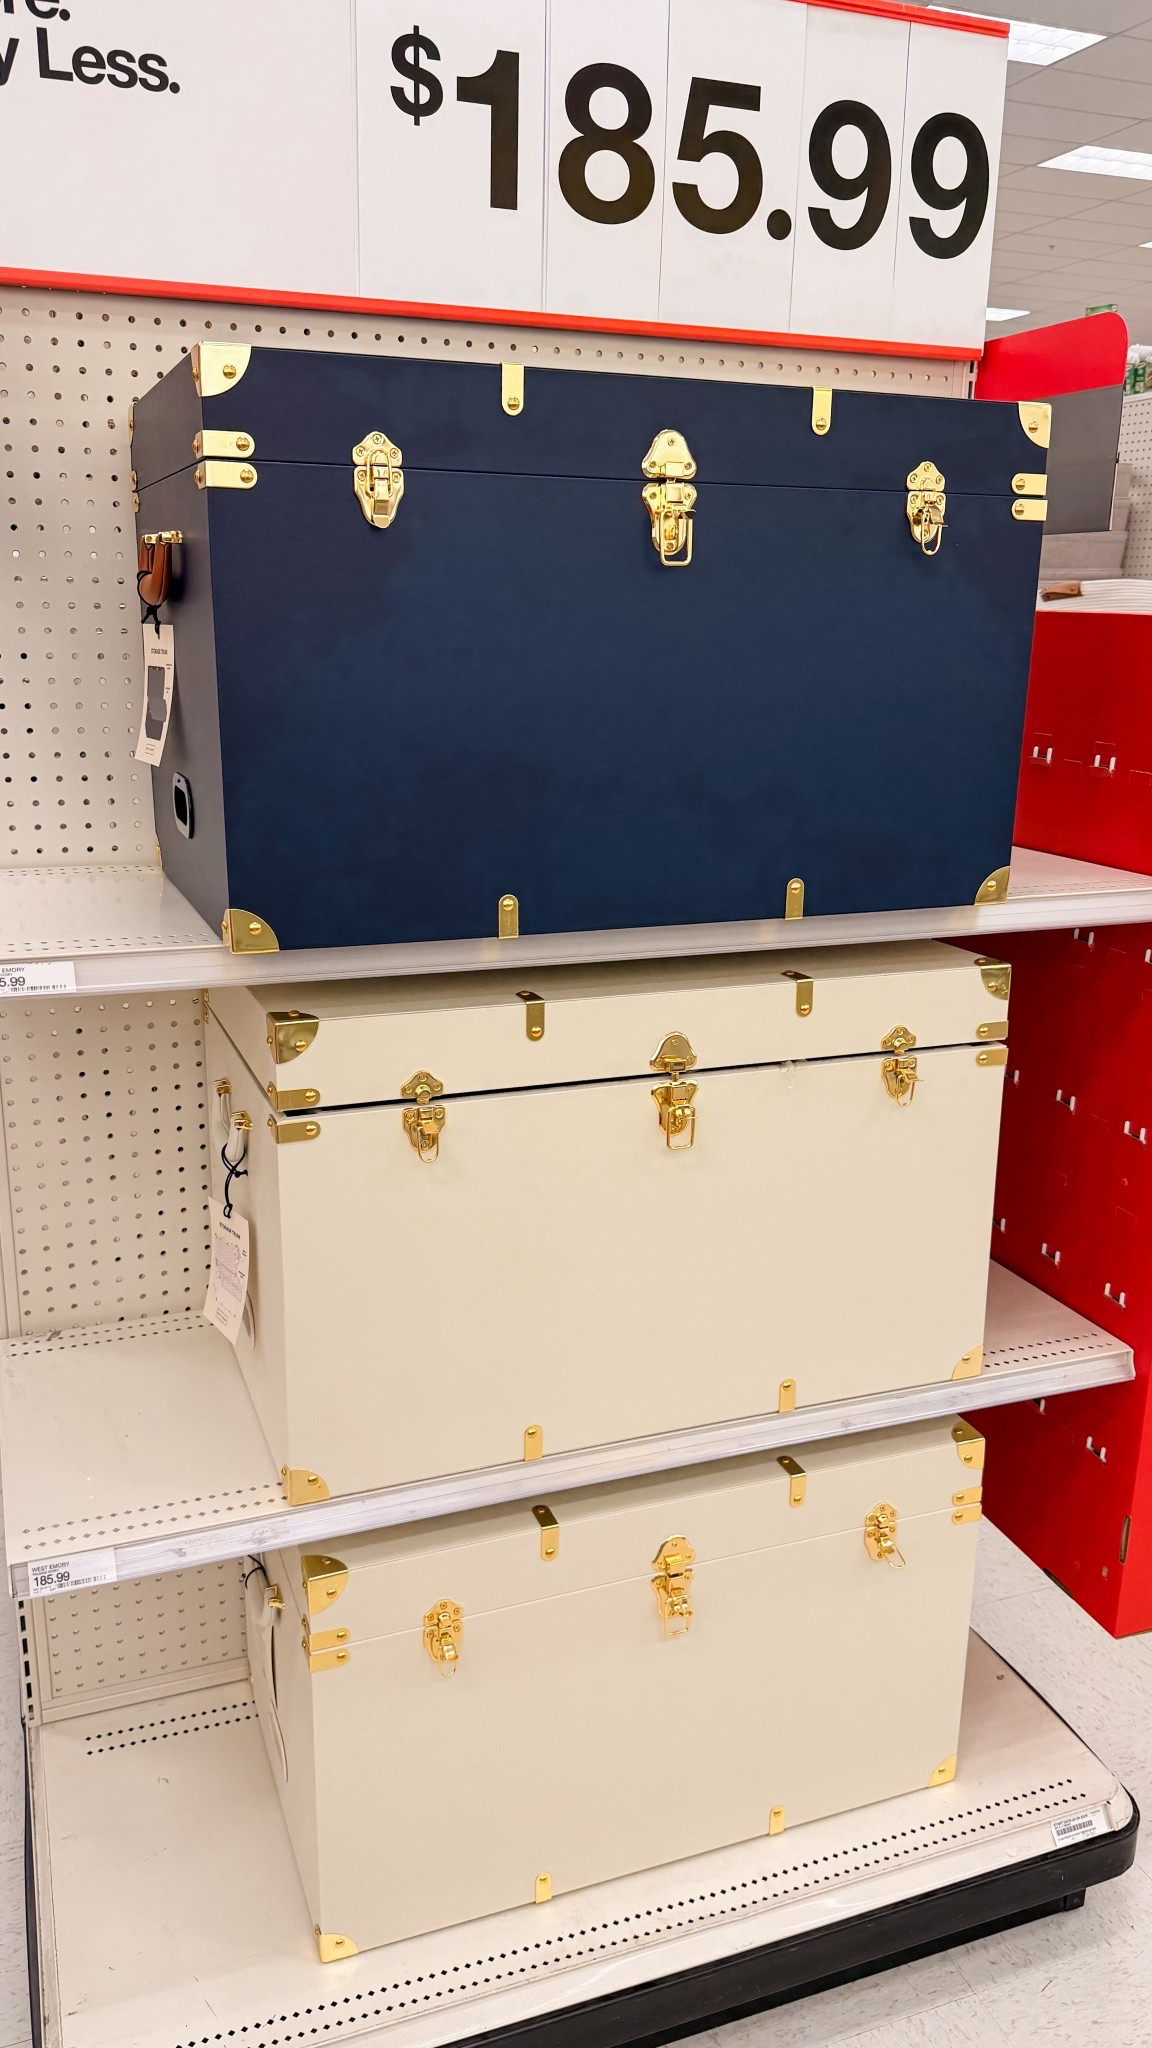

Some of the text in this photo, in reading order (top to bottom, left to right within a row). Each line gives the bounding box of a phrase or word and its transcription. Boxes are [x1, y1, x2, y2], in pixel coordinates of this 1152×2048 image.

[36, 26, 181, 94] Less.
[390, 24, 990, 260] $185.99
[1, 966, 26, 974] EMORY
[31, 1561, 70, 1573] WEST EMORY
[33, 1571, 70, 1587] 185.99
